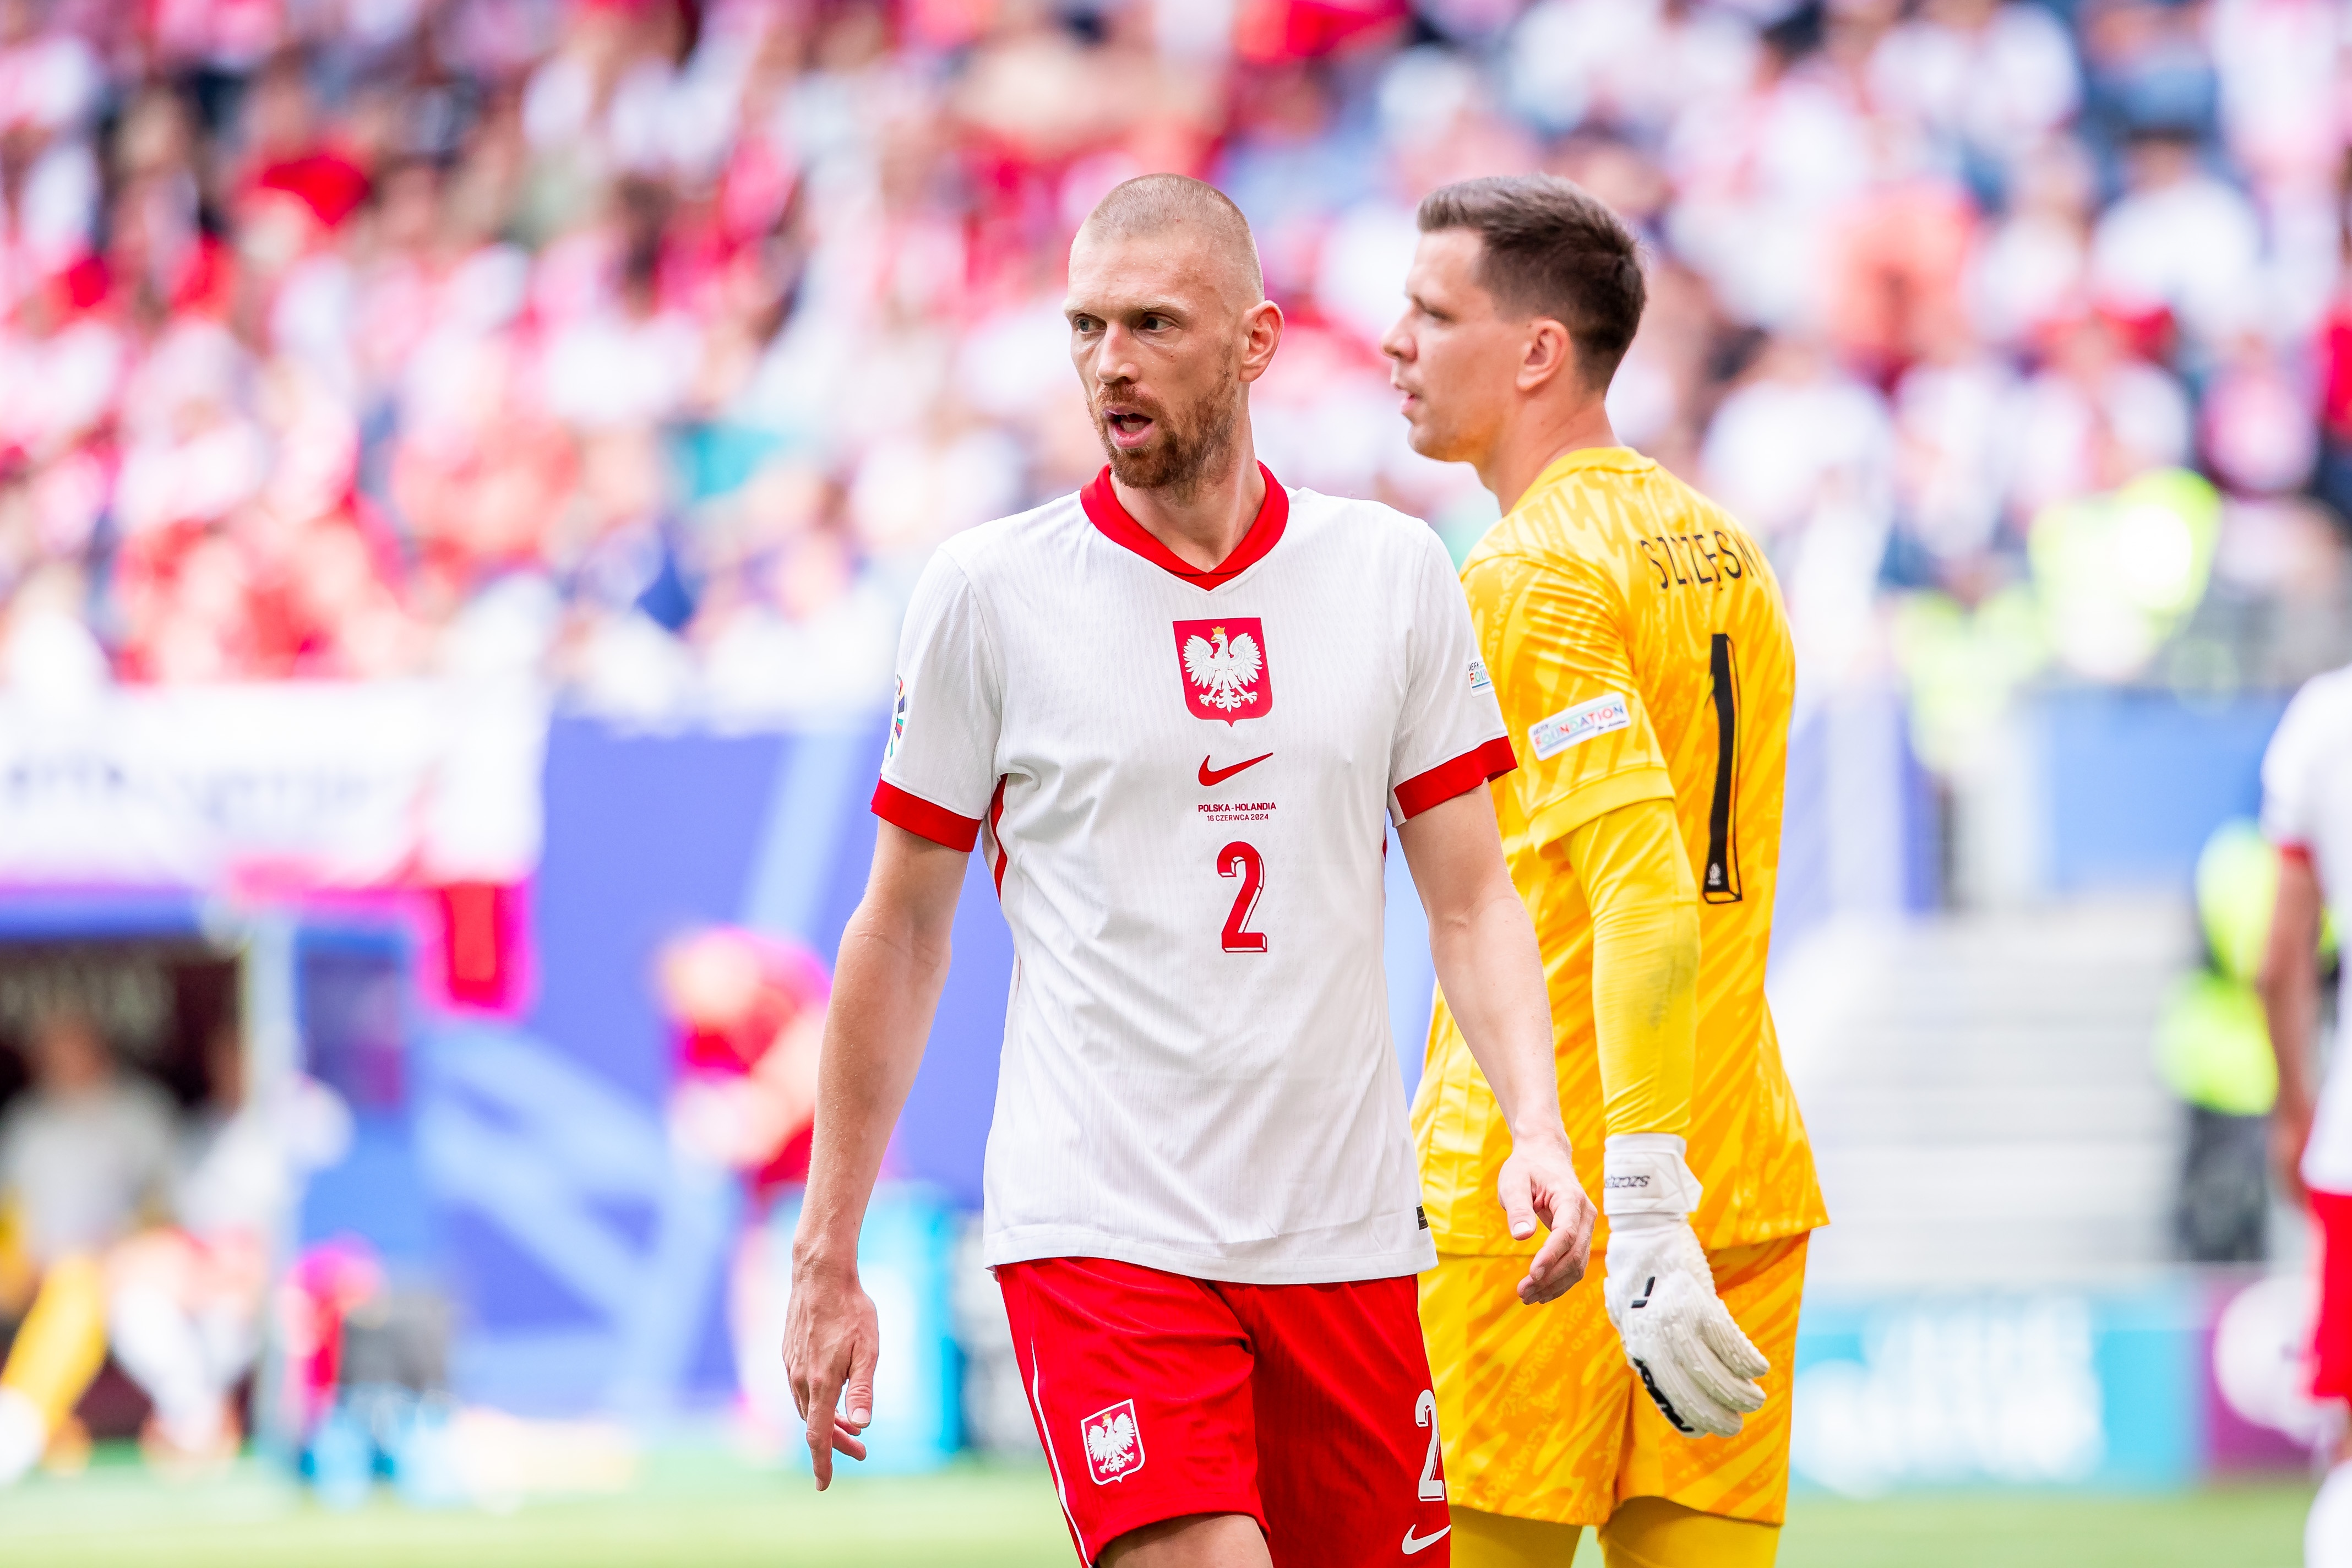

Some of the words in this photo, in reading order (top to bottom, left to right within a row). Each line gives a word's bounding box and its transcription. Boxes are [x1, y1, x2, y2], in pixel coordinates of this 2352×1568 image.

[1535, 705, 1624, 747] FOUNDATION
[1703, 633, 1743, 904] 1
[1198, 804, 1231, 812] POLSKA
[1235, 802, 1277, 811] HOLANDIA
[1217, 841, 1267, 953] 2
[1415, 1389, 1445, 1502] 2
